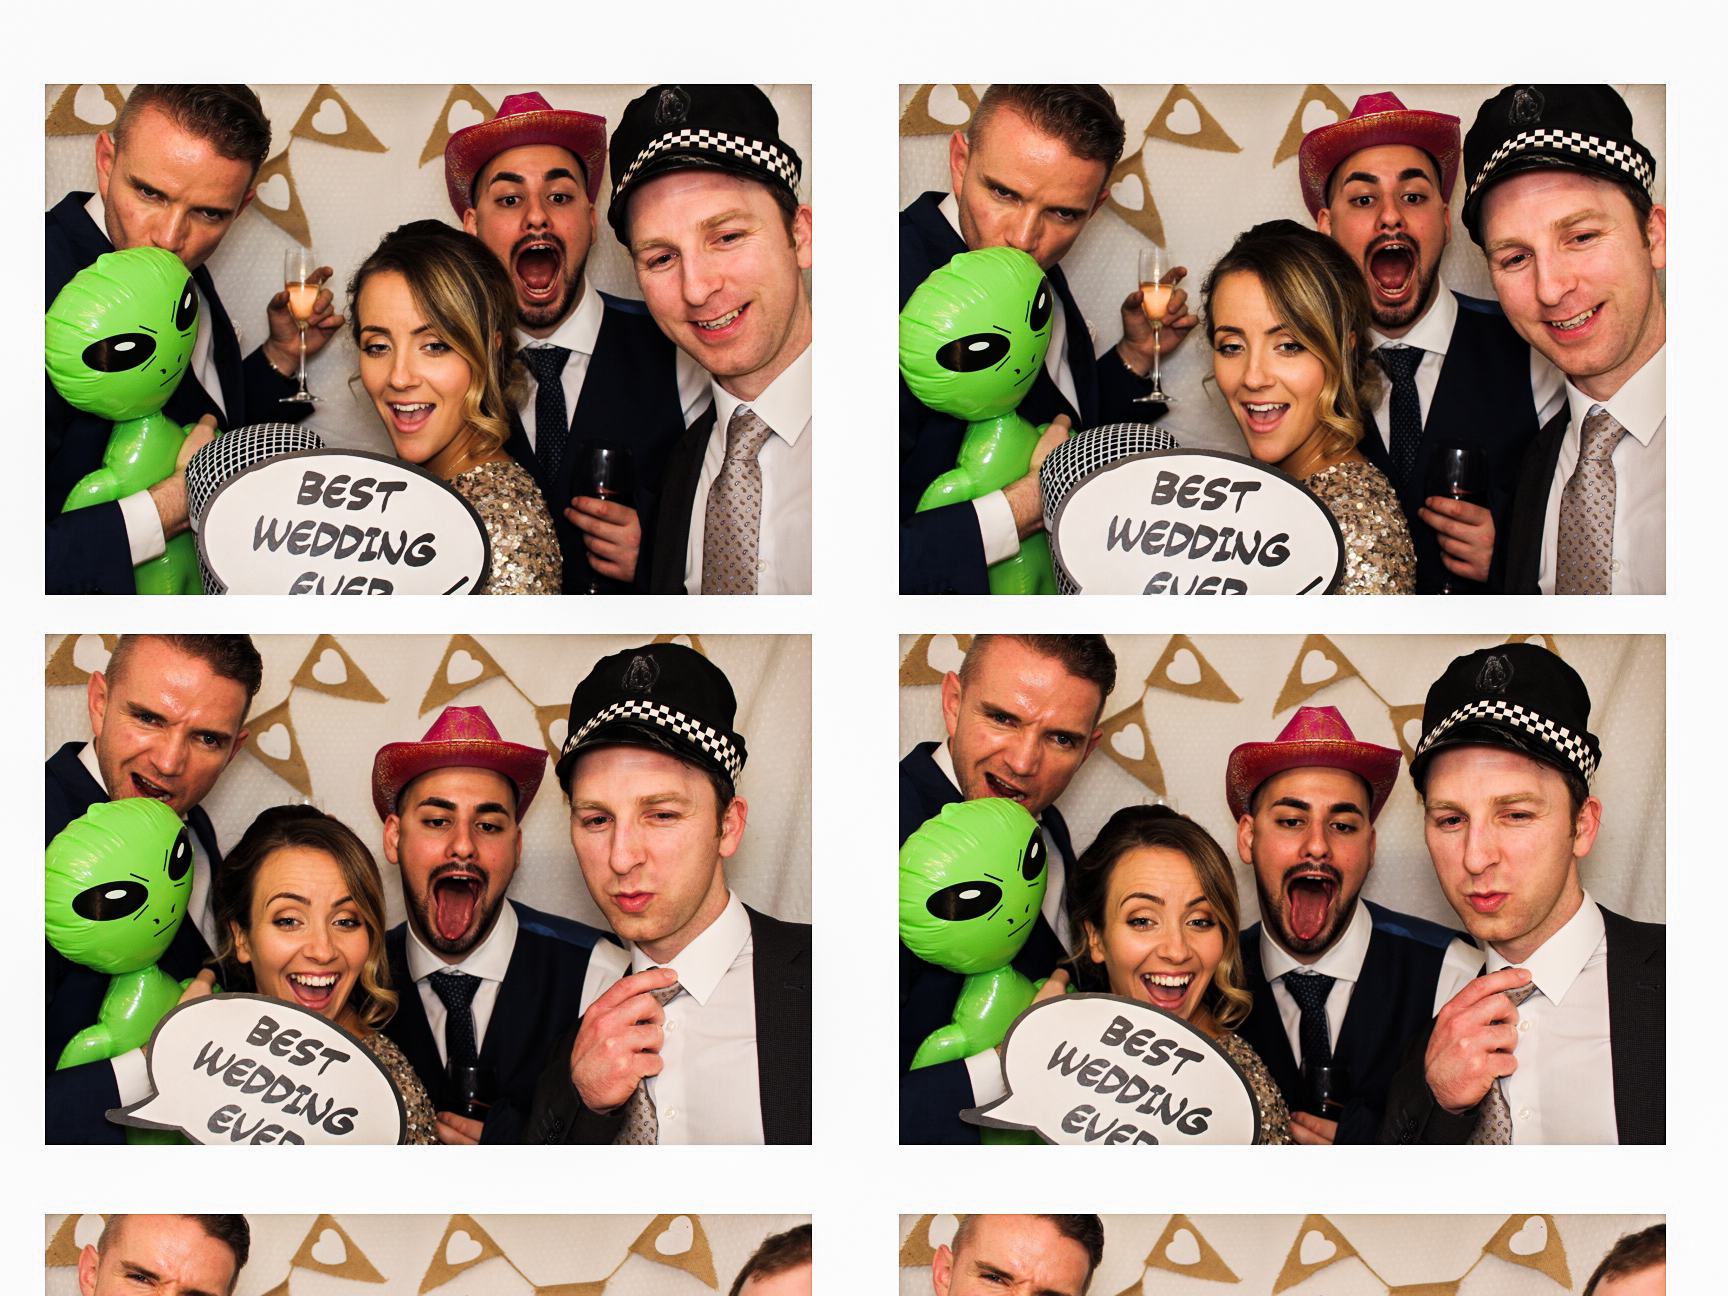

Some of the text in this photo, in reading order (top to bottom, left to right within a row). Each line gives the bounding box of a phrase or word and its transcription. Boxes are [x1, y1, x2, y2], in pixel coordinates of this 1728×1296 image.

[297, 470, 408, 513] BEST
[1151, 470, 1262, 513] BEST
[253, 515, 437, 567] WEDDING
[1107, 515, 1291, 567] WEDDING
[246, 1015, 350, 1075] BEST
[1100, 1015, 1204, 1075] BEST
[193, 1041, 358, 1135] WEDDING
[1047, 1041, 1212, 1135] WEDDING
